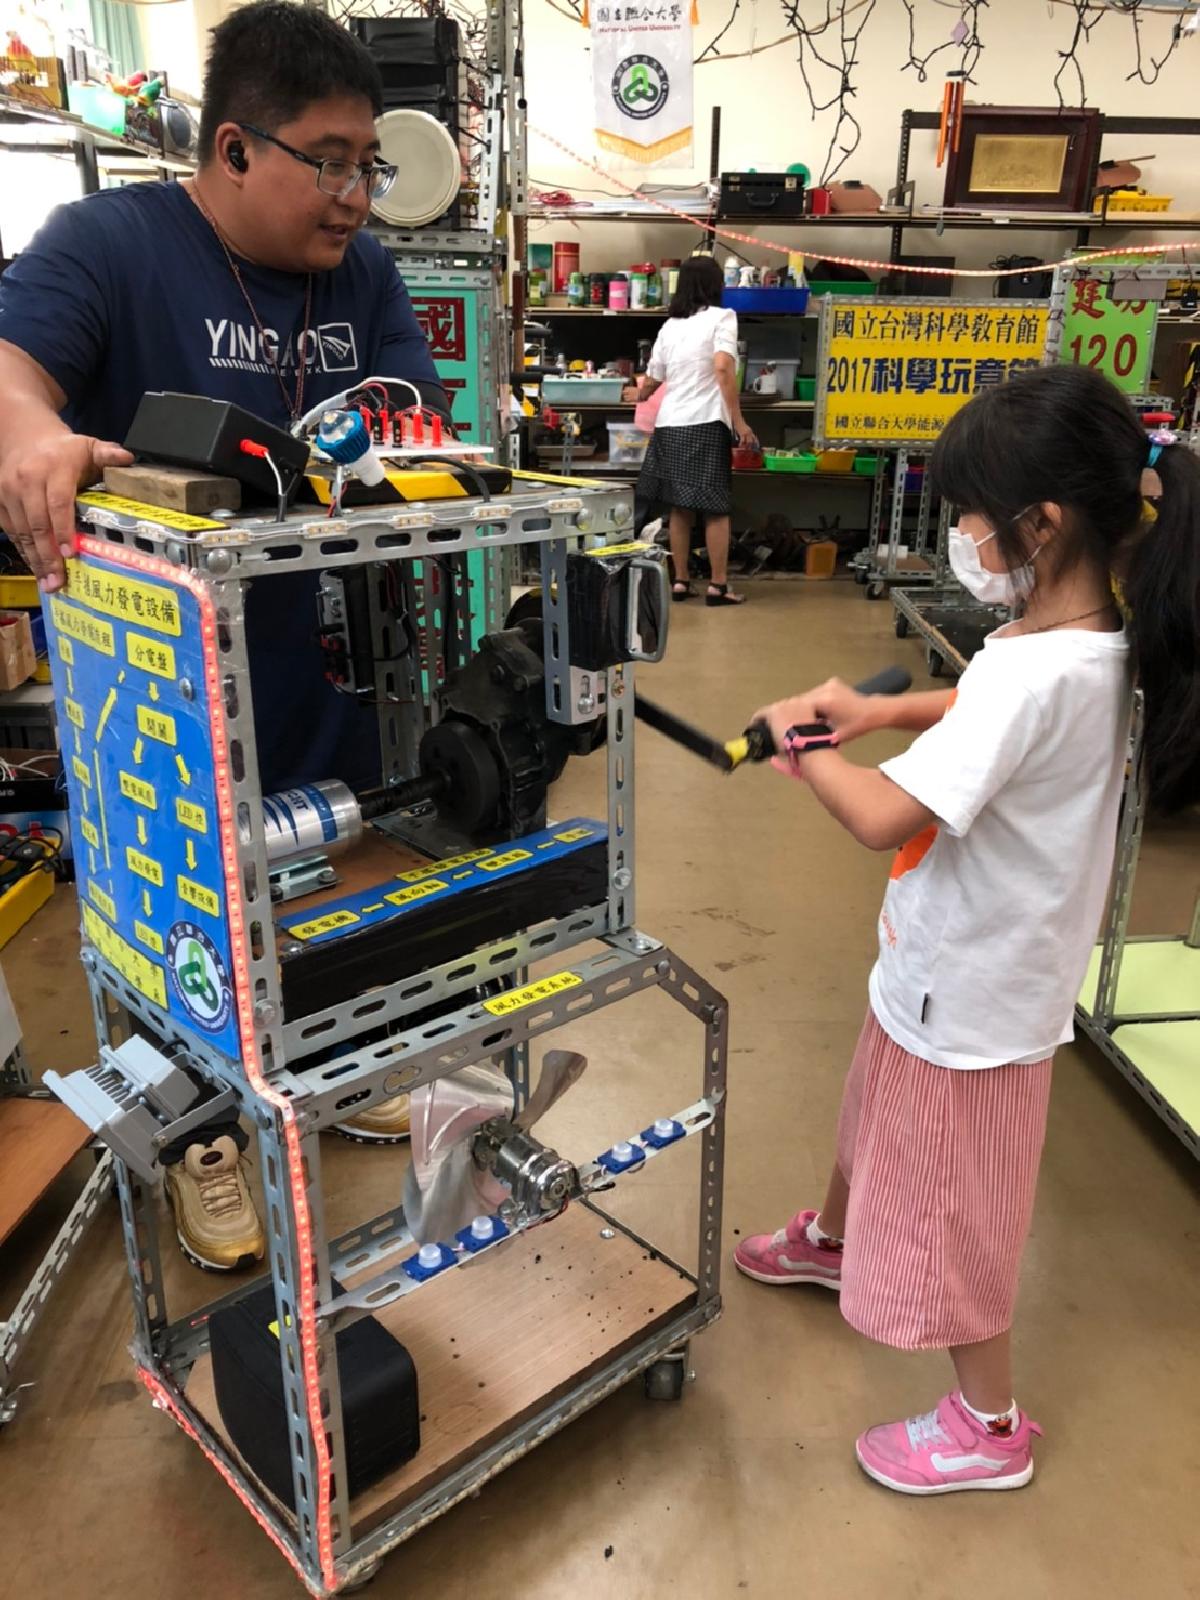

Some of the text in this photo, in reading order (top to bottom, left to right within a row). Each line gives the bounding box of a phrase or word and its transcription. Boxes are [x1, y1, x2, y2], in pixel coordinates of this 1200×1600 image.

[1070, 333, 1137, 377] 120
[835, 415, 952, 432] 國立聯合大學能源
